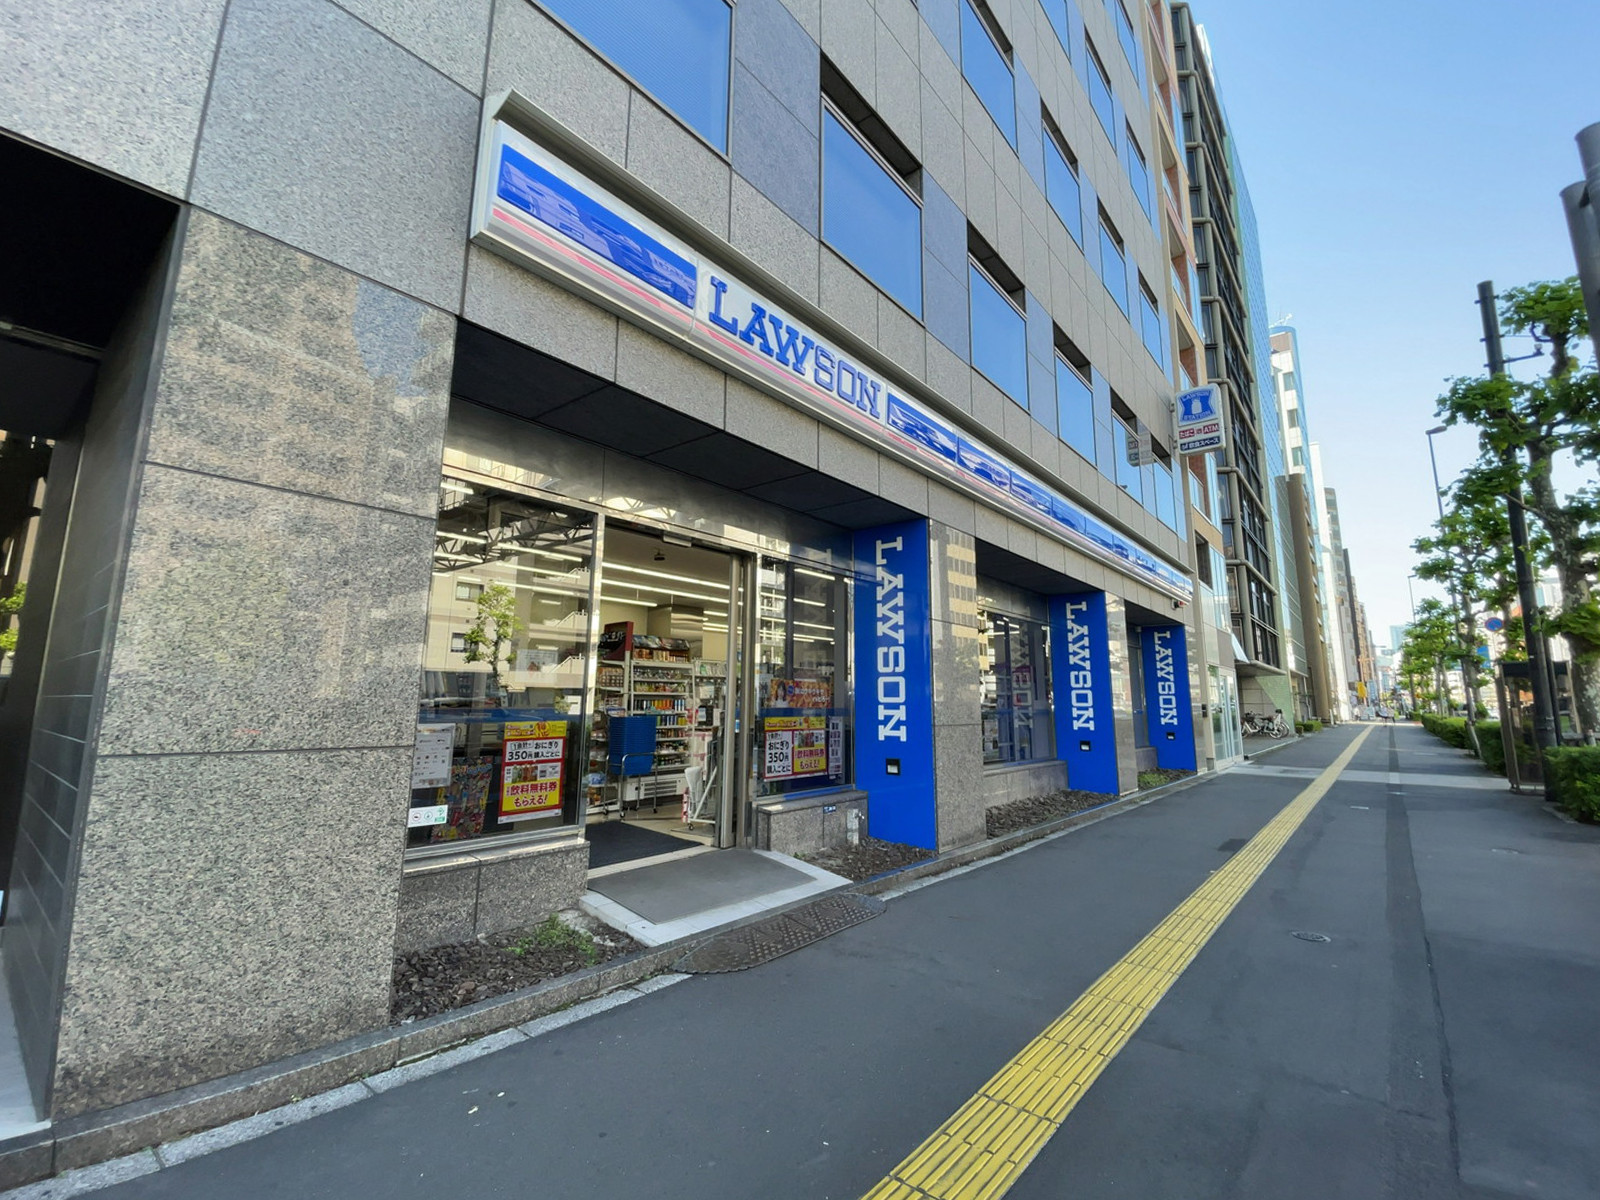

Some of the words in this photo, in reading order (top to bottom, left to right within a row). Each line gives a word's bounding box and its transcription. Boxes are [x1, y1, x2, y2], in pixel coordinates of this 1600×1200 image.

[709, 275, 881, 419] LAWSON
[1204, 424, 1218, 433] ATM
[875, 536, 907, 742] LAWSON
[1065, 601, 1095, 731] LAWSON
[1153, 630, 1178, 726] LAWSON
[768, 752, 789, 763] 350円
